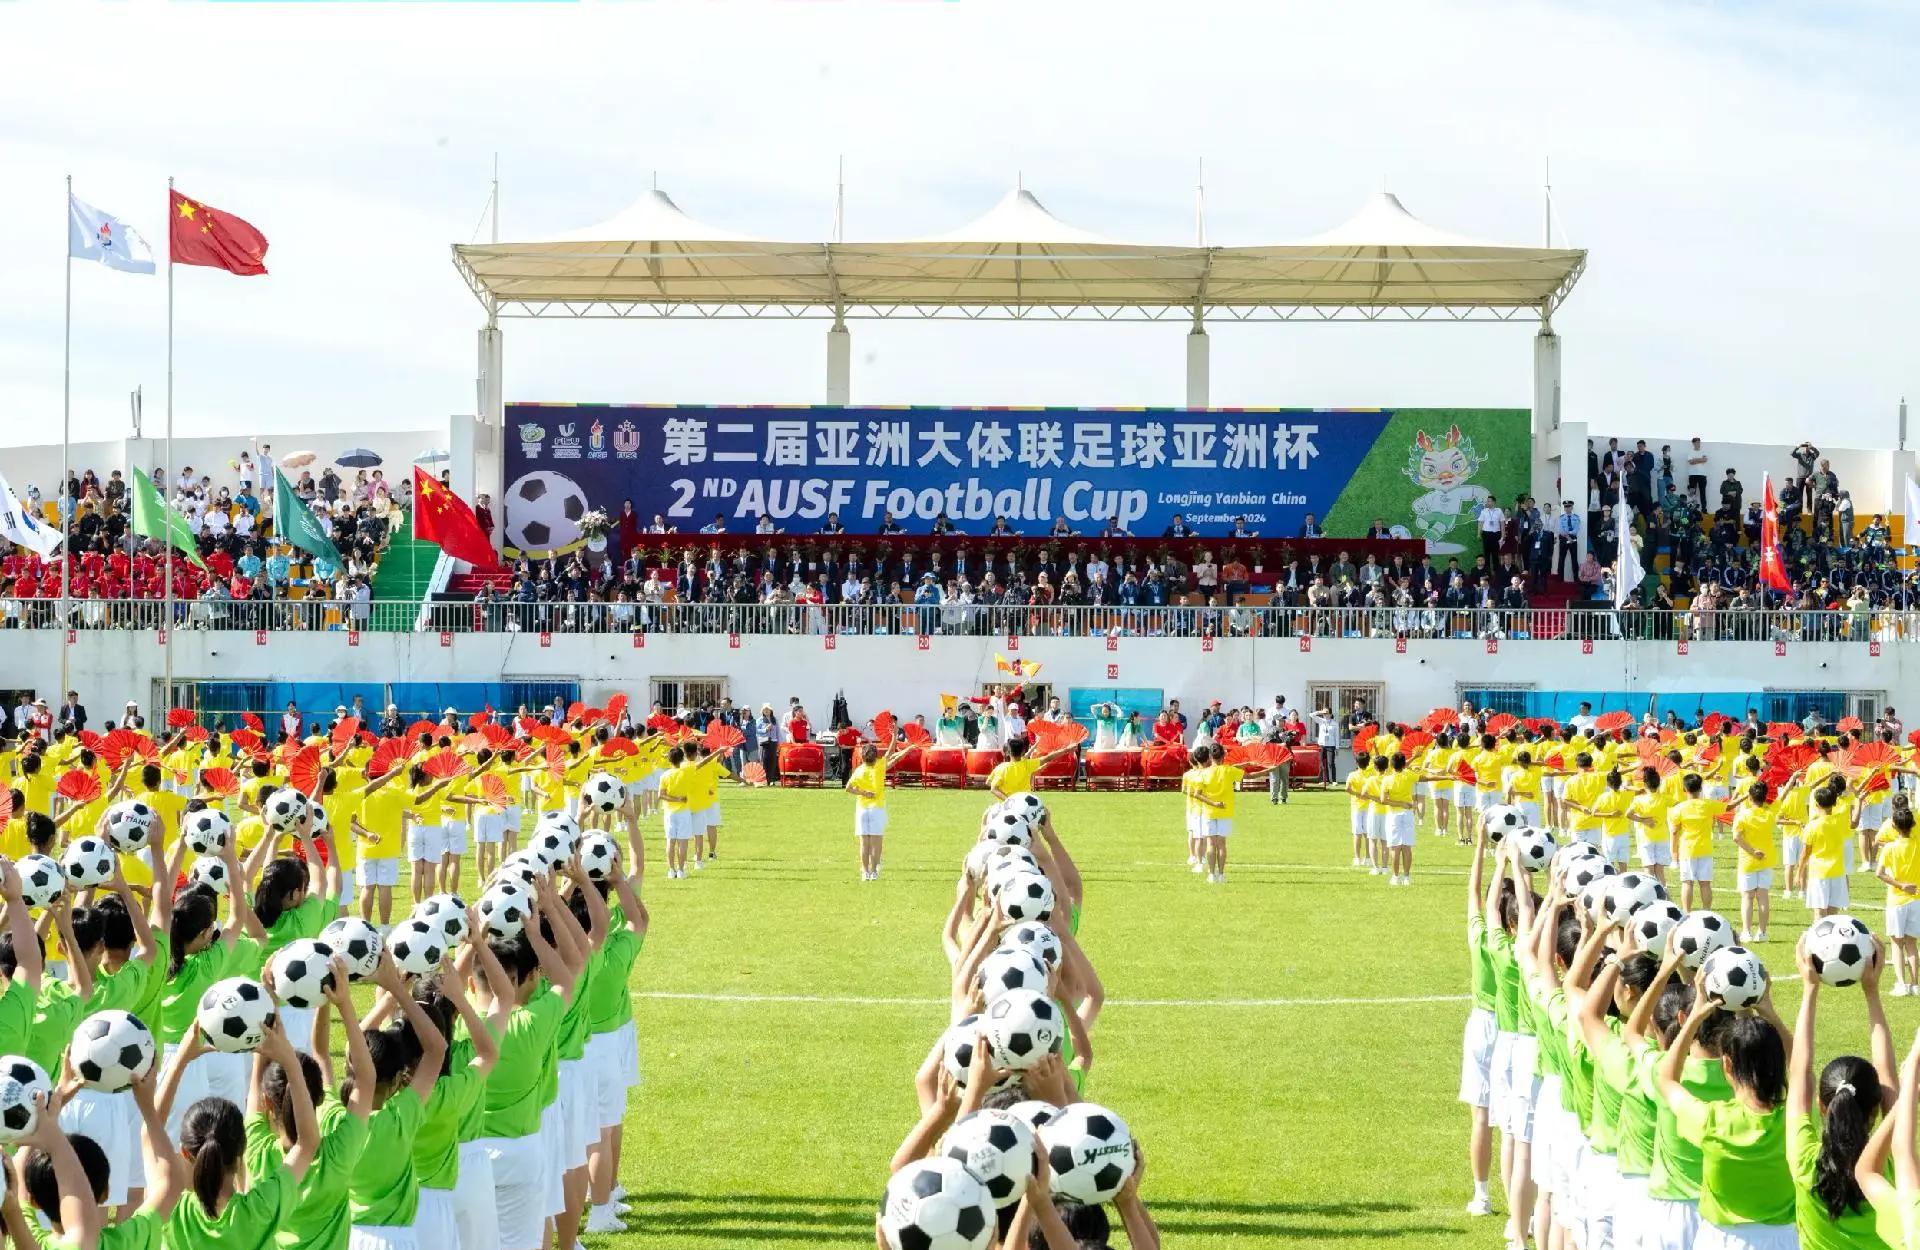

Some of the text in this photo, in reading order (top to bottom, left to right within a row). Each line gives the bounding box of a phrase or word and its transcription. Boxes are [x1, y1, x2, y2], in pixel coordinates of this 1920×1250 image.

[662, 418, 1319, 469] 第二届亚洲大体联足球亚洲杯
[1158, 490, 1307, 507] Longjing Yanbian China
[733, 478, 856, 519] AUSF
[862, 477, 1052, 520] Football
[1062, 480, 1148, 531] Cup
[257, 633, 266, 643] 13
[349, 633, 358, 643] 14
[441, 634, 450, 644] 15
[541, 635, 550, 645] 16
[730, 636, 739, 646] 18
[825, 637, 834, 647] 19
[919, 637, 928, 647] 20
[1009, 638, 1018, 648] 21
[1107, 639, 1117, 649] 22
[1202, 639, 1212, 649] 23
[1301, 640, 1310, 650] 24
[1396, 641, 1406, 650] 25
[1487, 642, 1497, 652] 26
[1583, 643, 1592, 652] 27
[1678, 643, 1688, 653] 28
[1870, 644, 1880, 654] 30
[1108, 667, 1118, 677] 22
